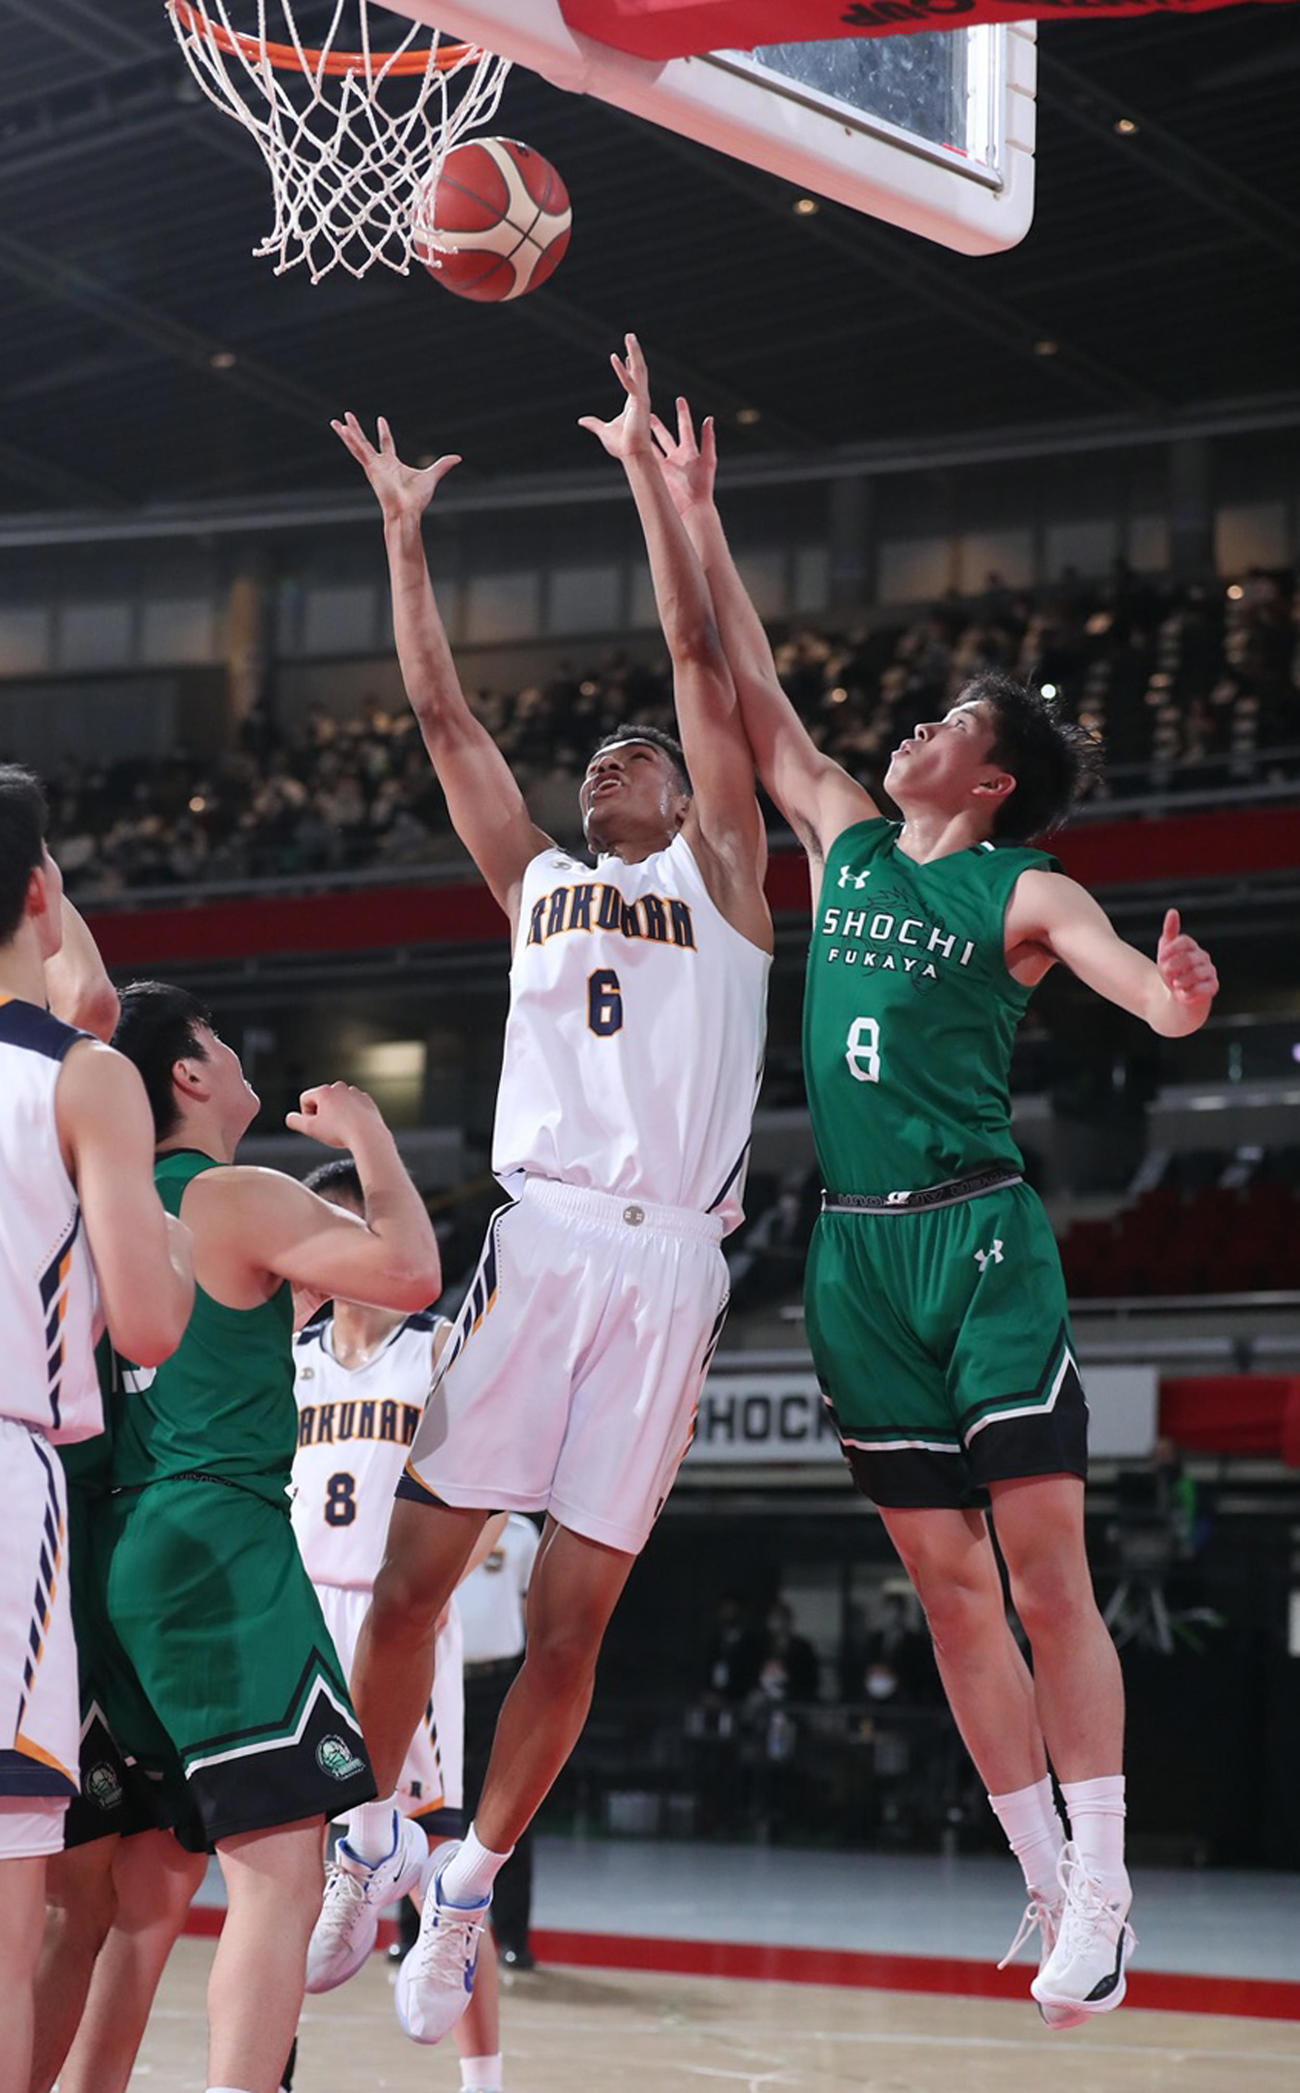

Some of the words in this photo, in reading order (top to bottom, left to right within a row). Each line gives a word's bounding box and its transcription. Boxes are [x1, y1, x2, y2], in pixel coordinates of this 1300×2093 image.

[822, 908, 976, 967] SHOCHI
[827, 948, 938, 979] FUKAYA
[587, 968, 624, 1038] 6
[845, 1016, 881, 1084] 8
[298, 1398, 423, 1448] AKUNAN
[692, 1394, 838, 1441] HOC
[324, 1471, 357, 1528] 8
